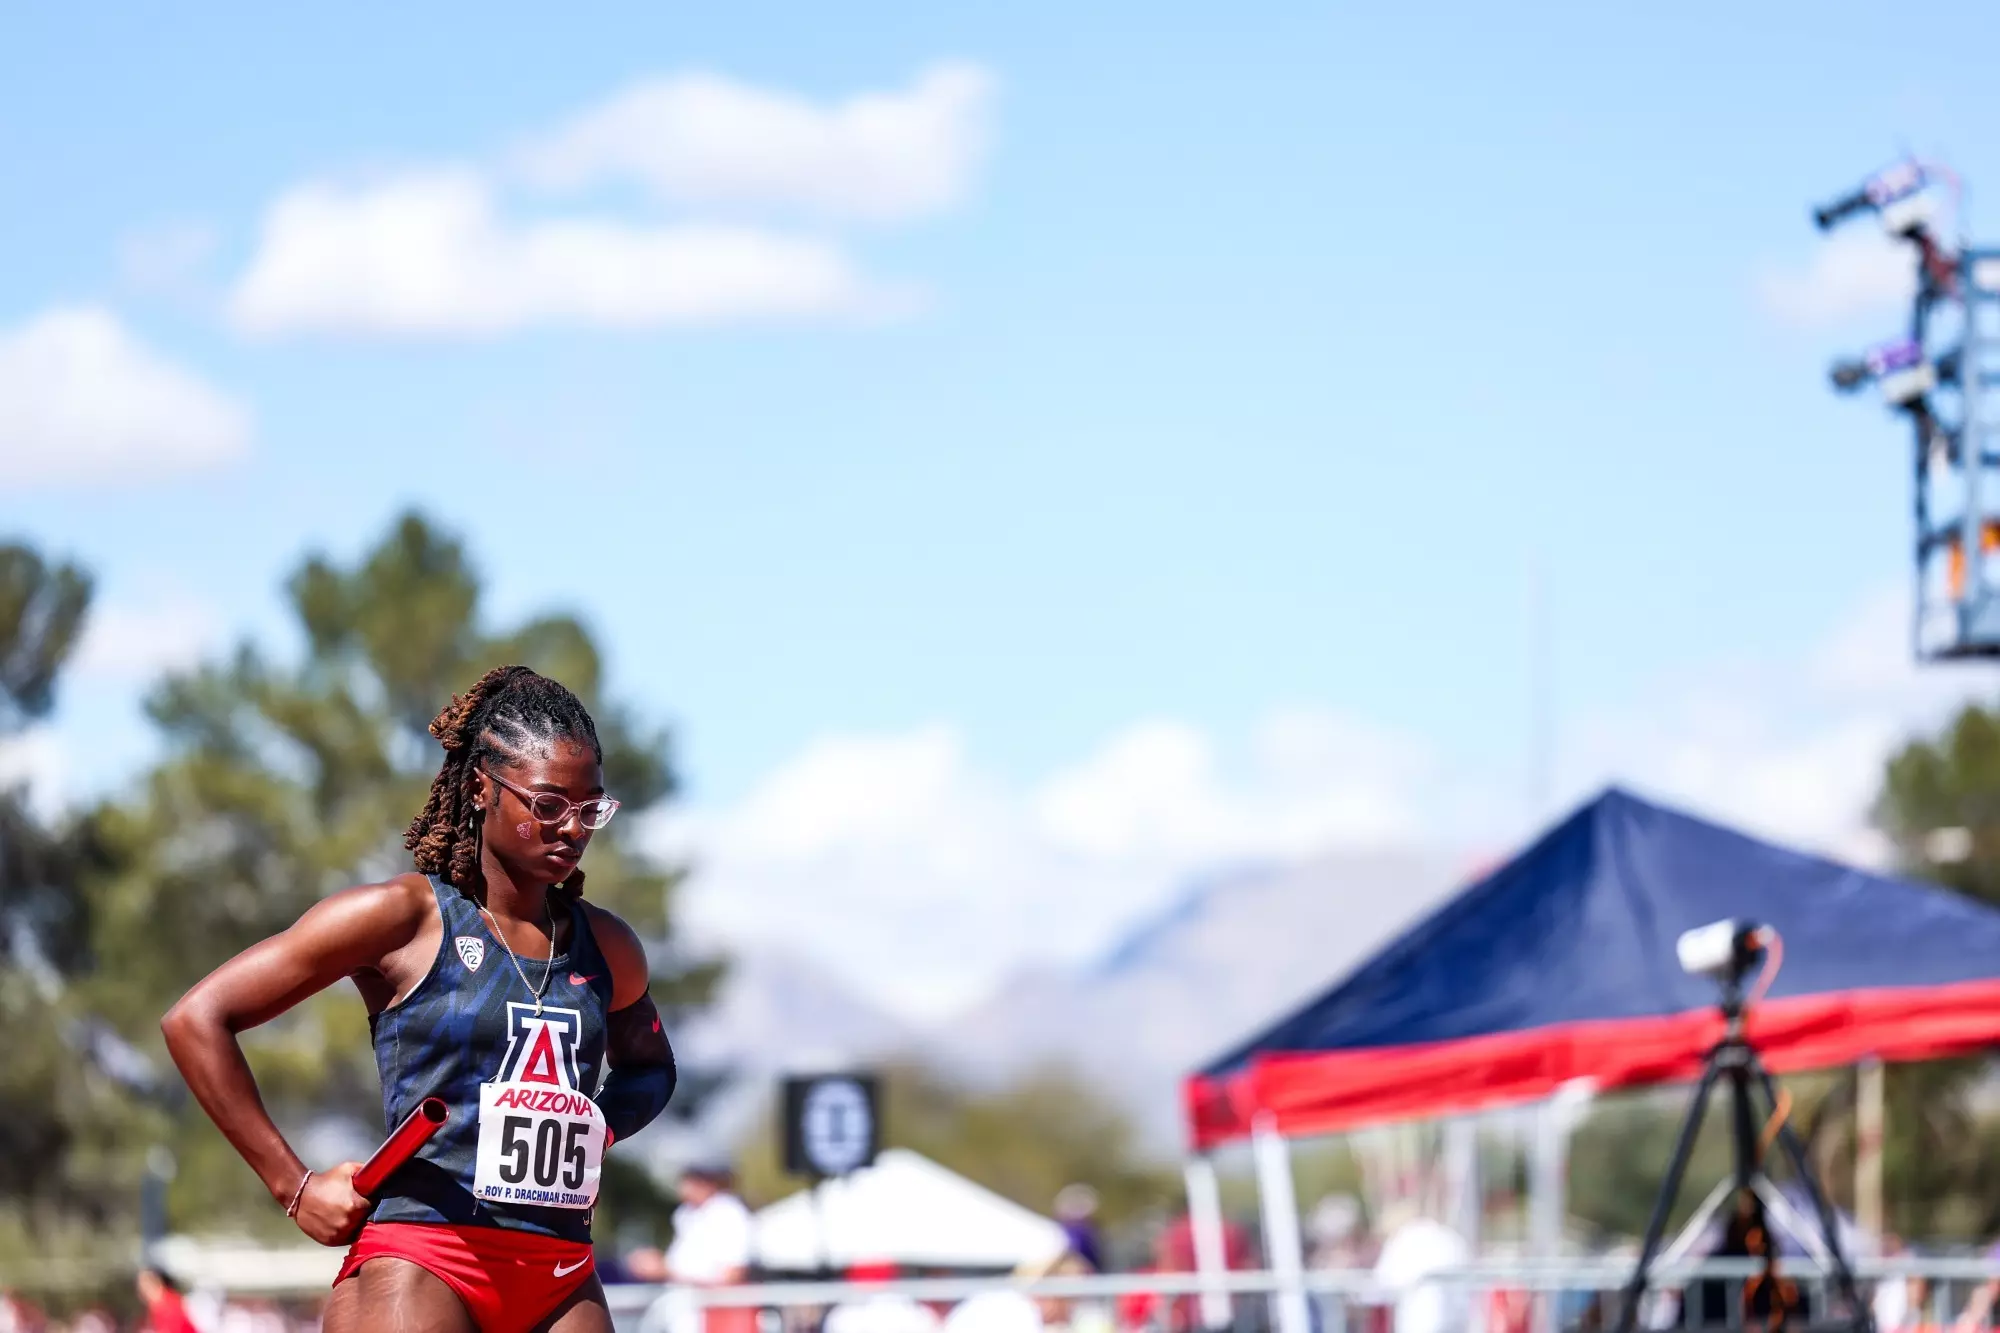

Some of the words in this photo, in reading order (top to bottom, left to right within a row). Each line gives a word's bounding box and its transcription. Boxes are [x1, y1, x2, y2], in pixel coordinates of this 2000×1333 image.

[466, 954, 478, 965] 12
[495, 1001, 581, 1091] A
[494, 1088, 593, 1117] ARIZONA
[499, 1115, 590, 1190] 505
[484, 1185, 504, 1198] ROY
[505, 1187, 512, 1199] P.
[514, 1188, 560, 1203] DRACHMAN
[560, 1192, 590, 1205] STADIUM
